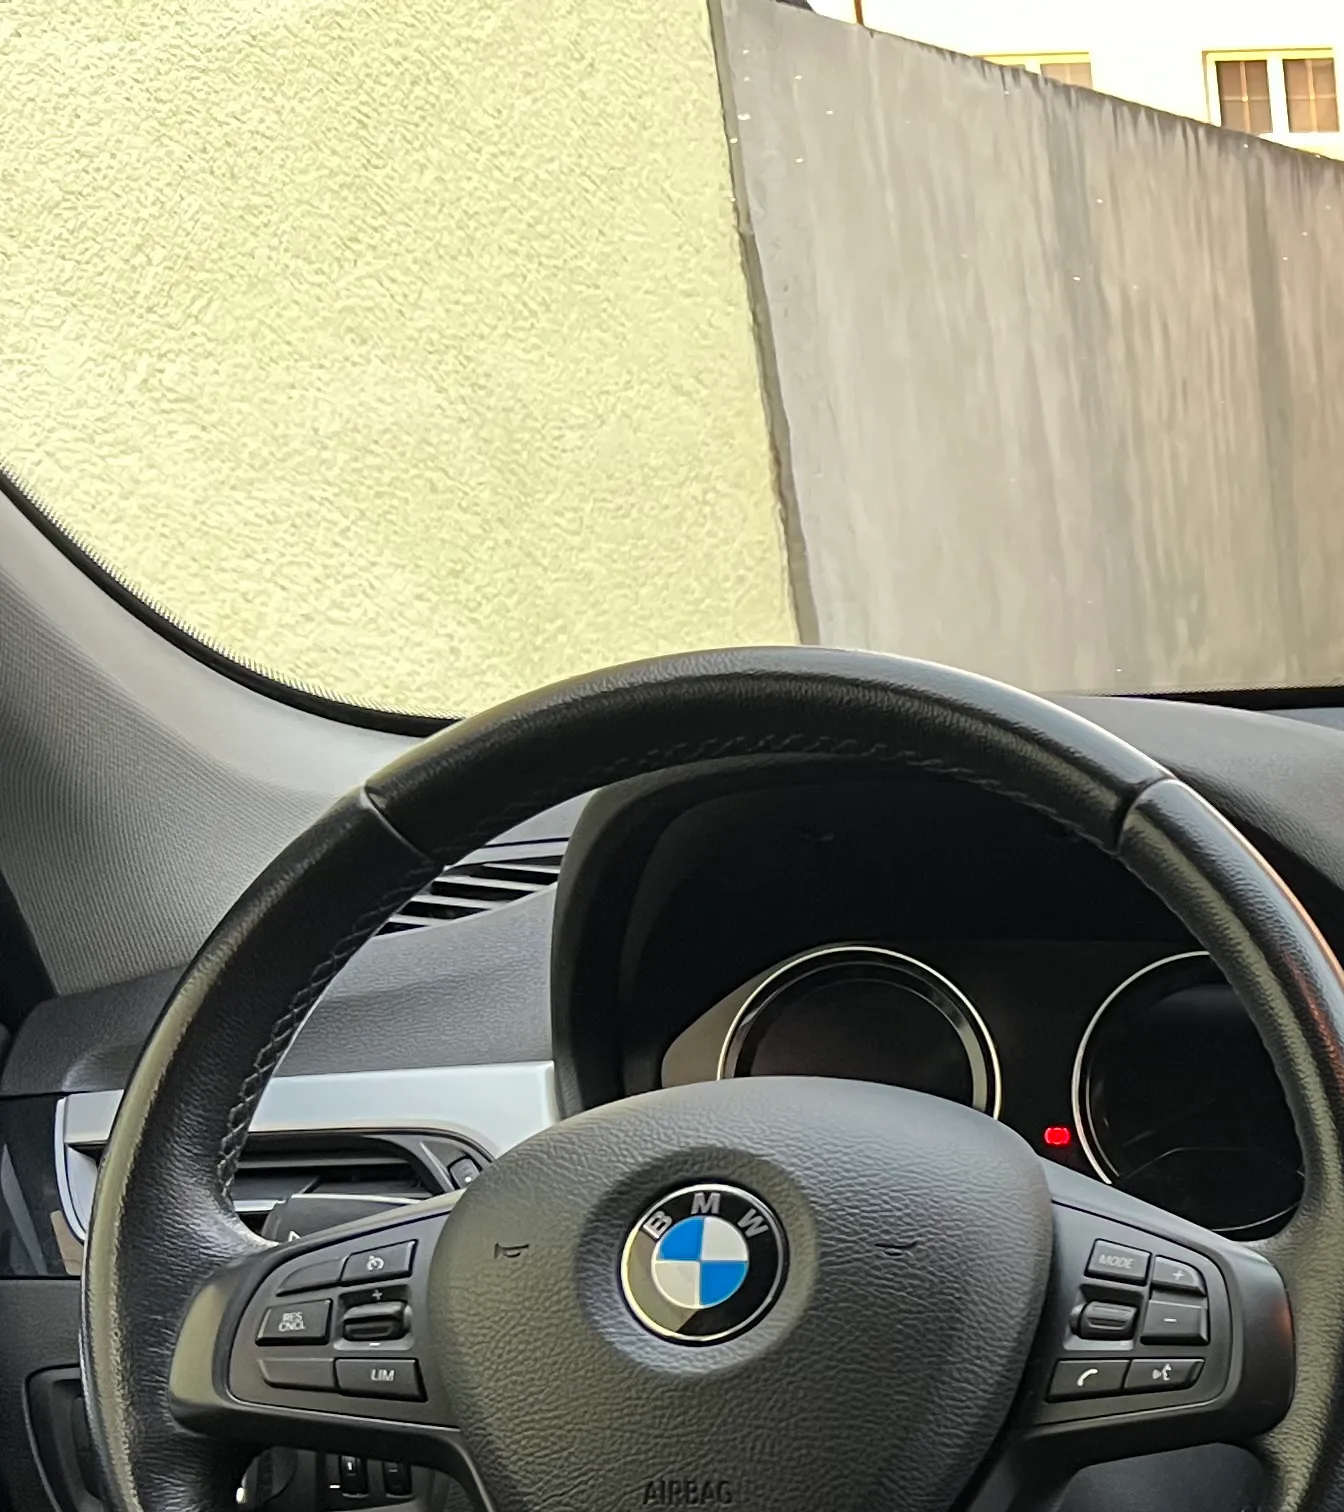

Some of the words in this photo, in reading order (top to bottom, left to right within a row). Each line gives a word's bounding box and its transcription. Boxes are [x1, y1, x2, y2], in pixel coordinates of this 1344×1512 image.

[643, 1192, 769, 1240] BMW
[1098, 1254, 1136, 1270] MODE
[282, 1311, 303, 1321] RES
[278, 1320, 306, 1332] CNCL
[371, 1369, 395, 1381] LIM
[642, 1480, 733, 1505] AIRBAG
